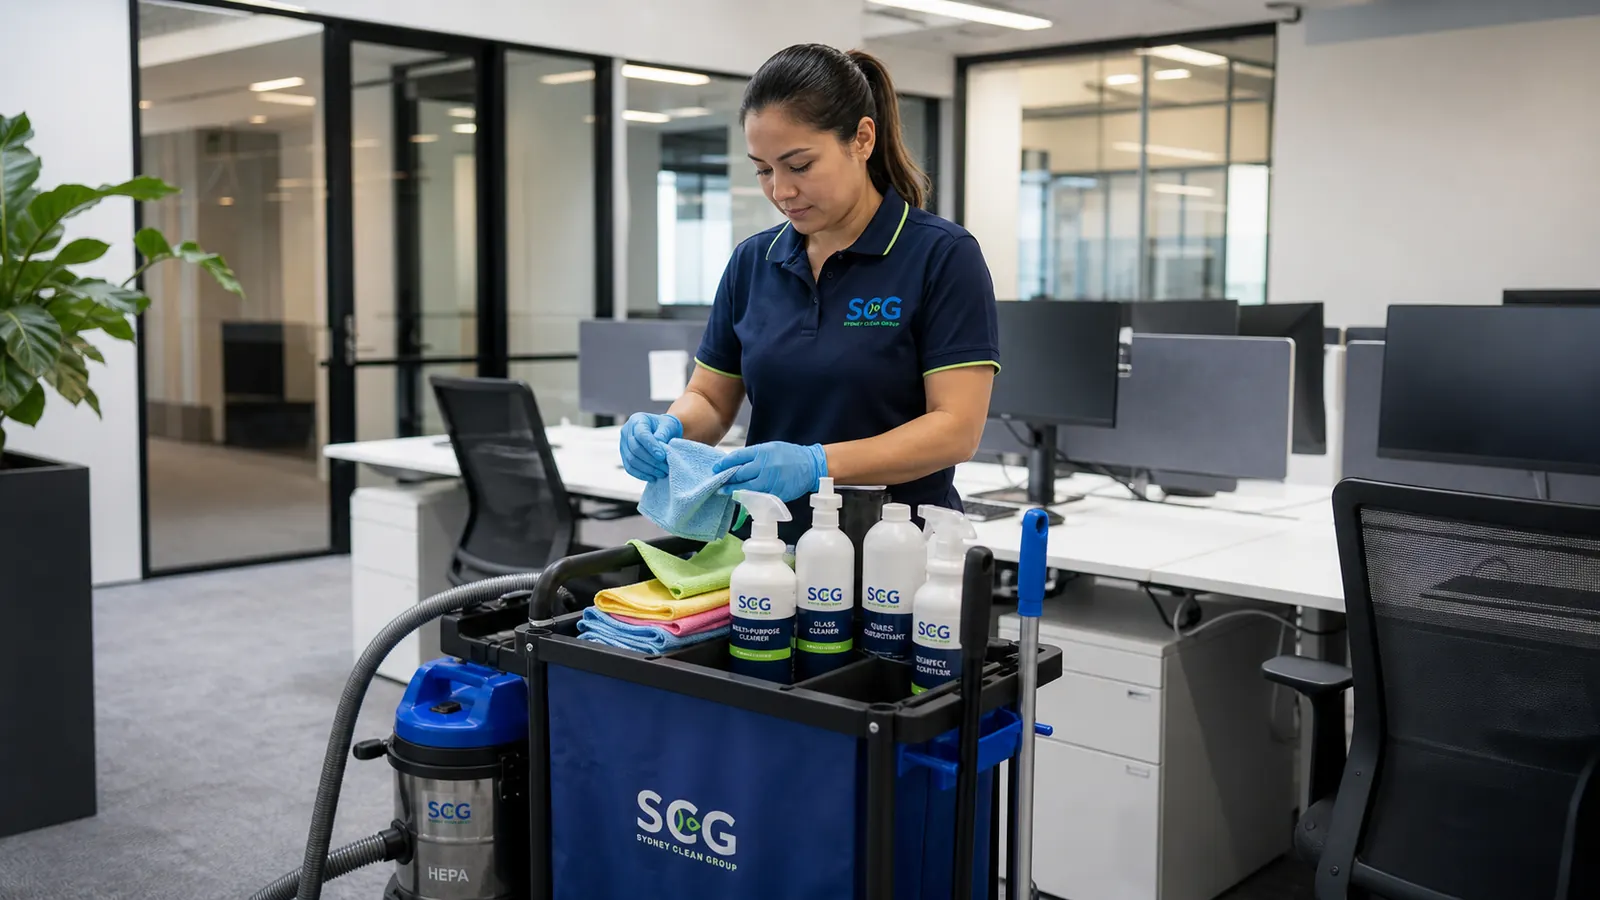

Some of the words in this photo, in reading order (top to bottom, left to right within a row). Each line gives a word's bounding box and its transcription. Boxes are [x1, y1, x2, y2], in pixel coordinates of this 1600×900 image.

[846, 296, 902, 320] SCG
[738, 595, 771, 611] SCG
[808, 587, 842, 602] SCG
[867, 586, 900, 604] SCG
[809, 627, 840, 635] CLEANER
[813, 620, 836, 628] GLASS
[918, 621, 950, 639] SCG
[428, 801, 471, 820] SCG
[637, 789, 737, 856] SCG
[636, 833, 670, 850] SYDNEY
[672, 845, 703, 861] CLEAN
[705, 855, 737, 871] GROUP
[428, 866, 469, 882] HEPA
